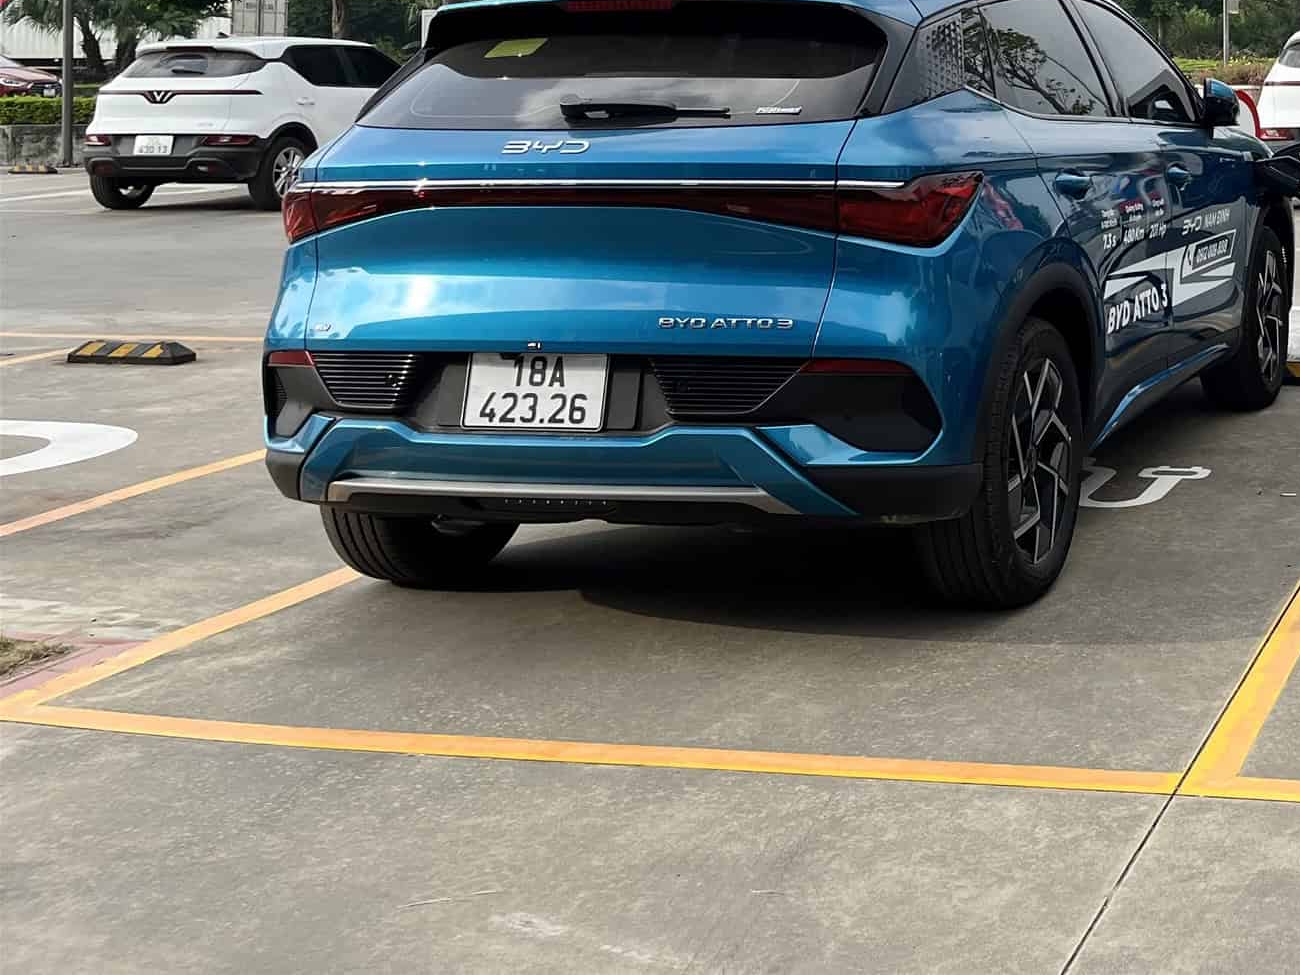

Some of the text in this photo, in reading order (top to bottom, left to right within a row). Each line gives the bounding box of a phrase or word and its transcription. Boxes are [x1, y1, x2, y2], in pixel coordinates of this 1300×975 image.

[501, 140, 590, 154] BYD
[1107, 283, 1168, 335] BYD ATTO 3
[514, 356, 565, 387] 18A
[480, 392, 588, 424] 423.26
